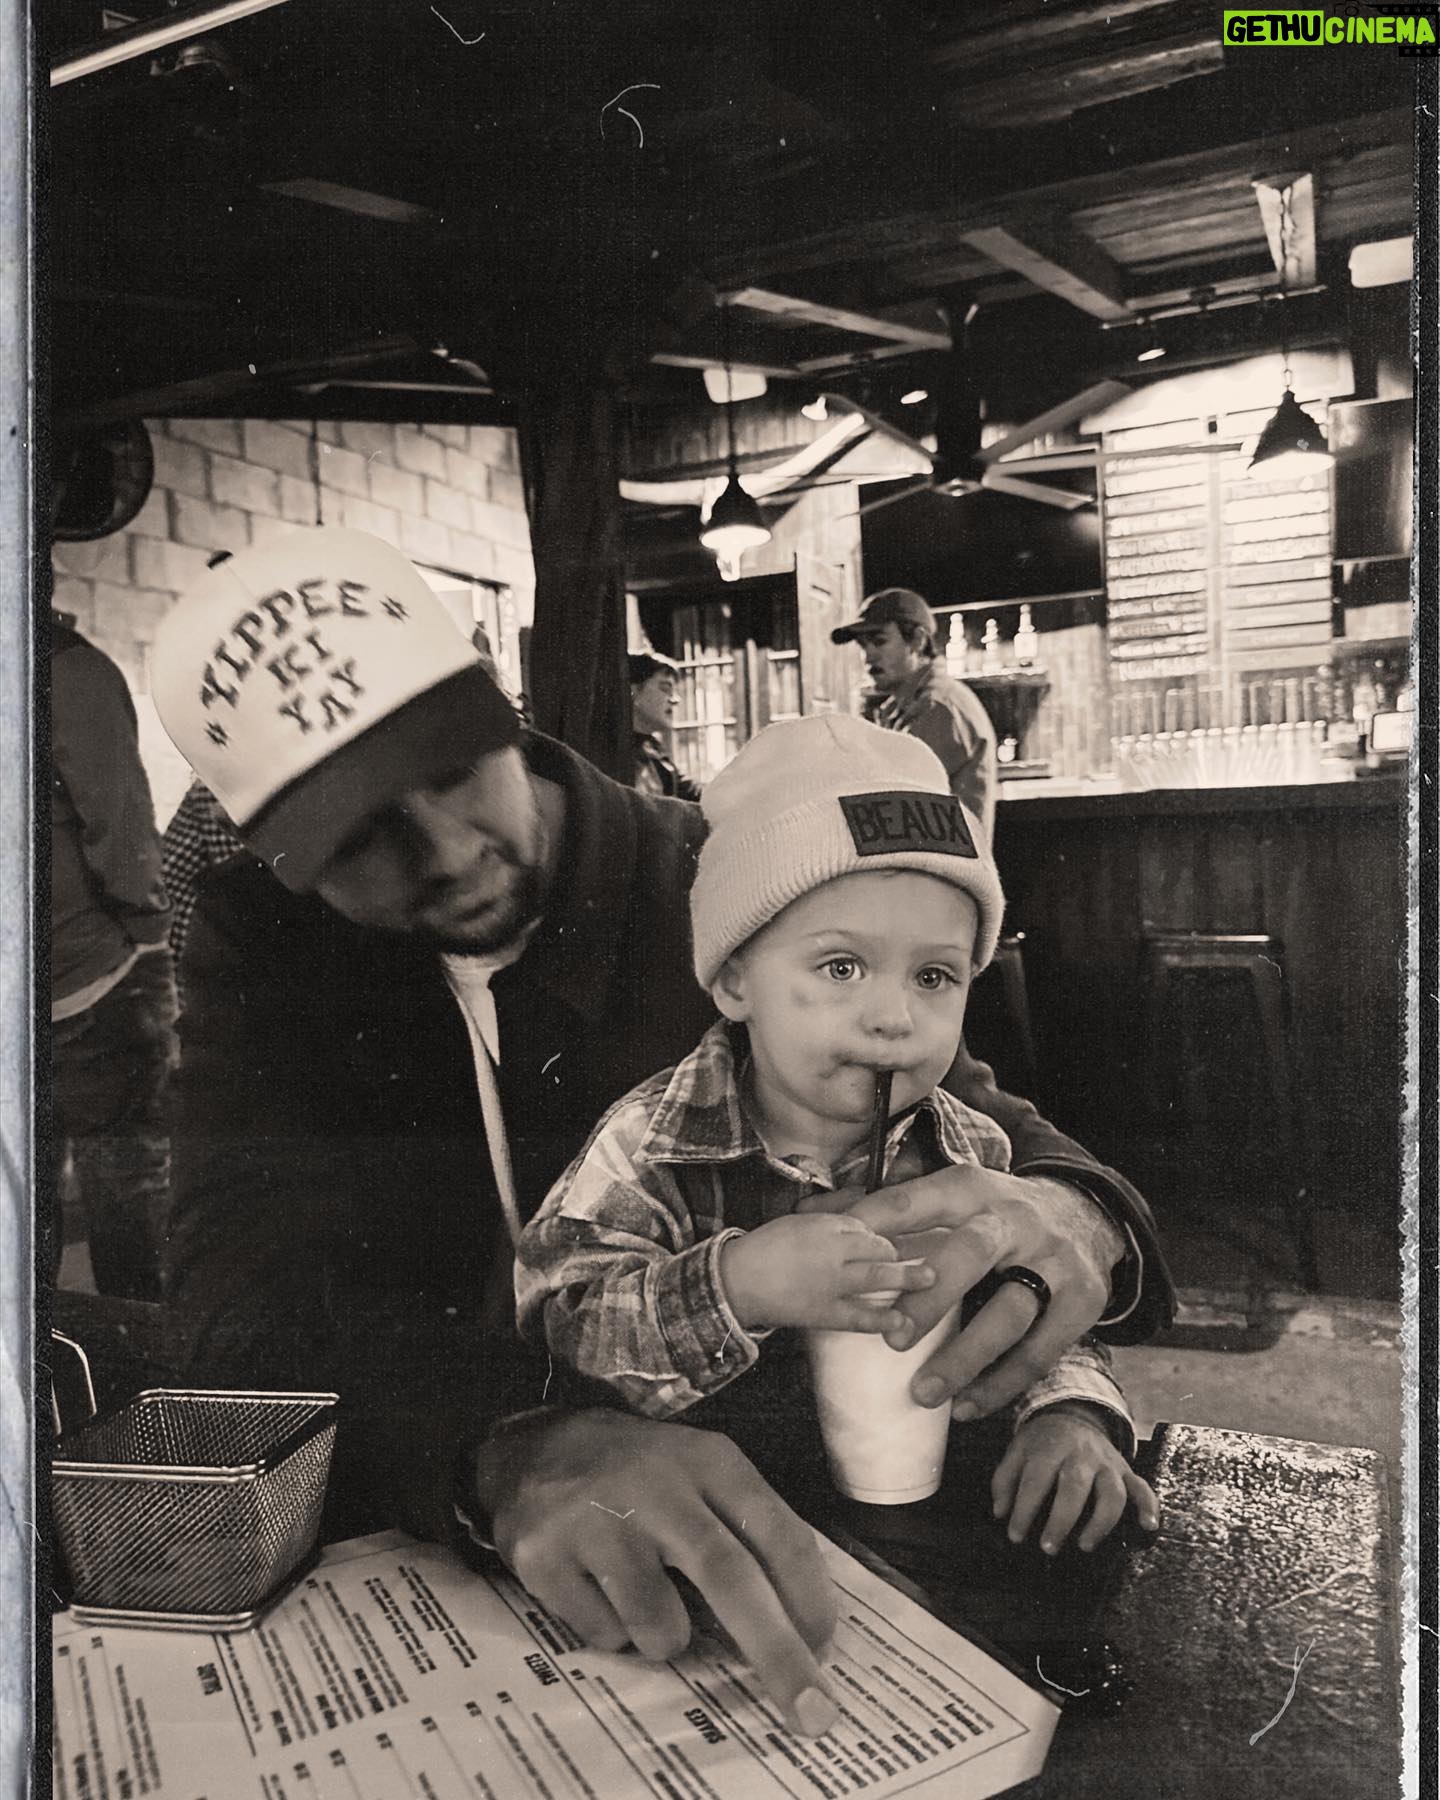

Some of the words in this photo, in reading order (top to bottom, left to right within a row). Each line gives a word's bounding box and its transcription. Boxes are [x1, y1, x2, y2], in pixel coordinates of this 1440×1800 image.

[201, 576, 370, 710] YIPPEE
[266, 628, 332, 690] KI
[278, 657, 365, 735] YAY
[849, 799, 971, 845] BEAUX
[524, 1653, 560, 1686] SWEETS
[684, 1708, 727, 1744] SHAKES
